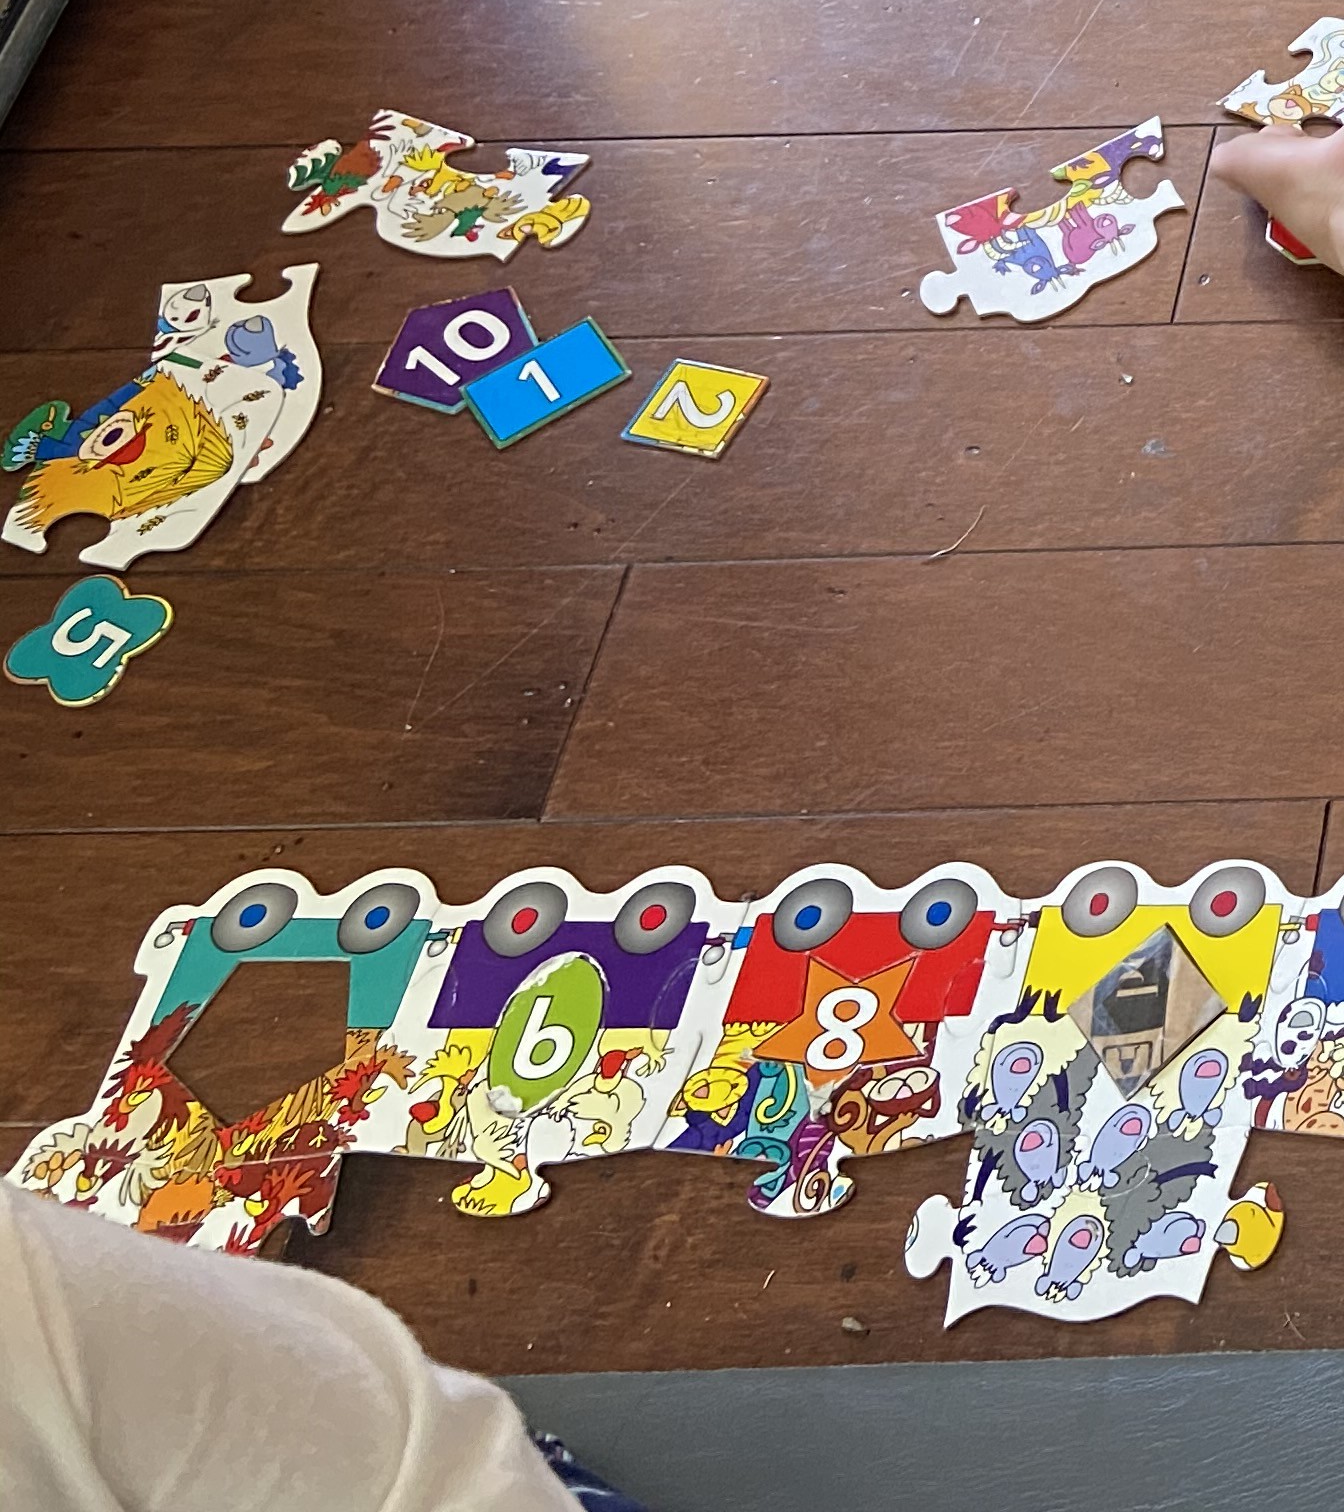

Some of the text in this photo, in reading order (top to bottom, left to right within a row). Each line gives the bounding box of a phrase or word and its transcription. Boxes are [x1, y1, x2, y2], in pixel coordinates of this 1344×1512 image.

[405, 309, 511, 386] 10
[518, 359, 561, 403] 1
[648, 379, 737, 429] 2
[51, 607, 132, 669] 5
[804, 986, 880, 1070] 8
